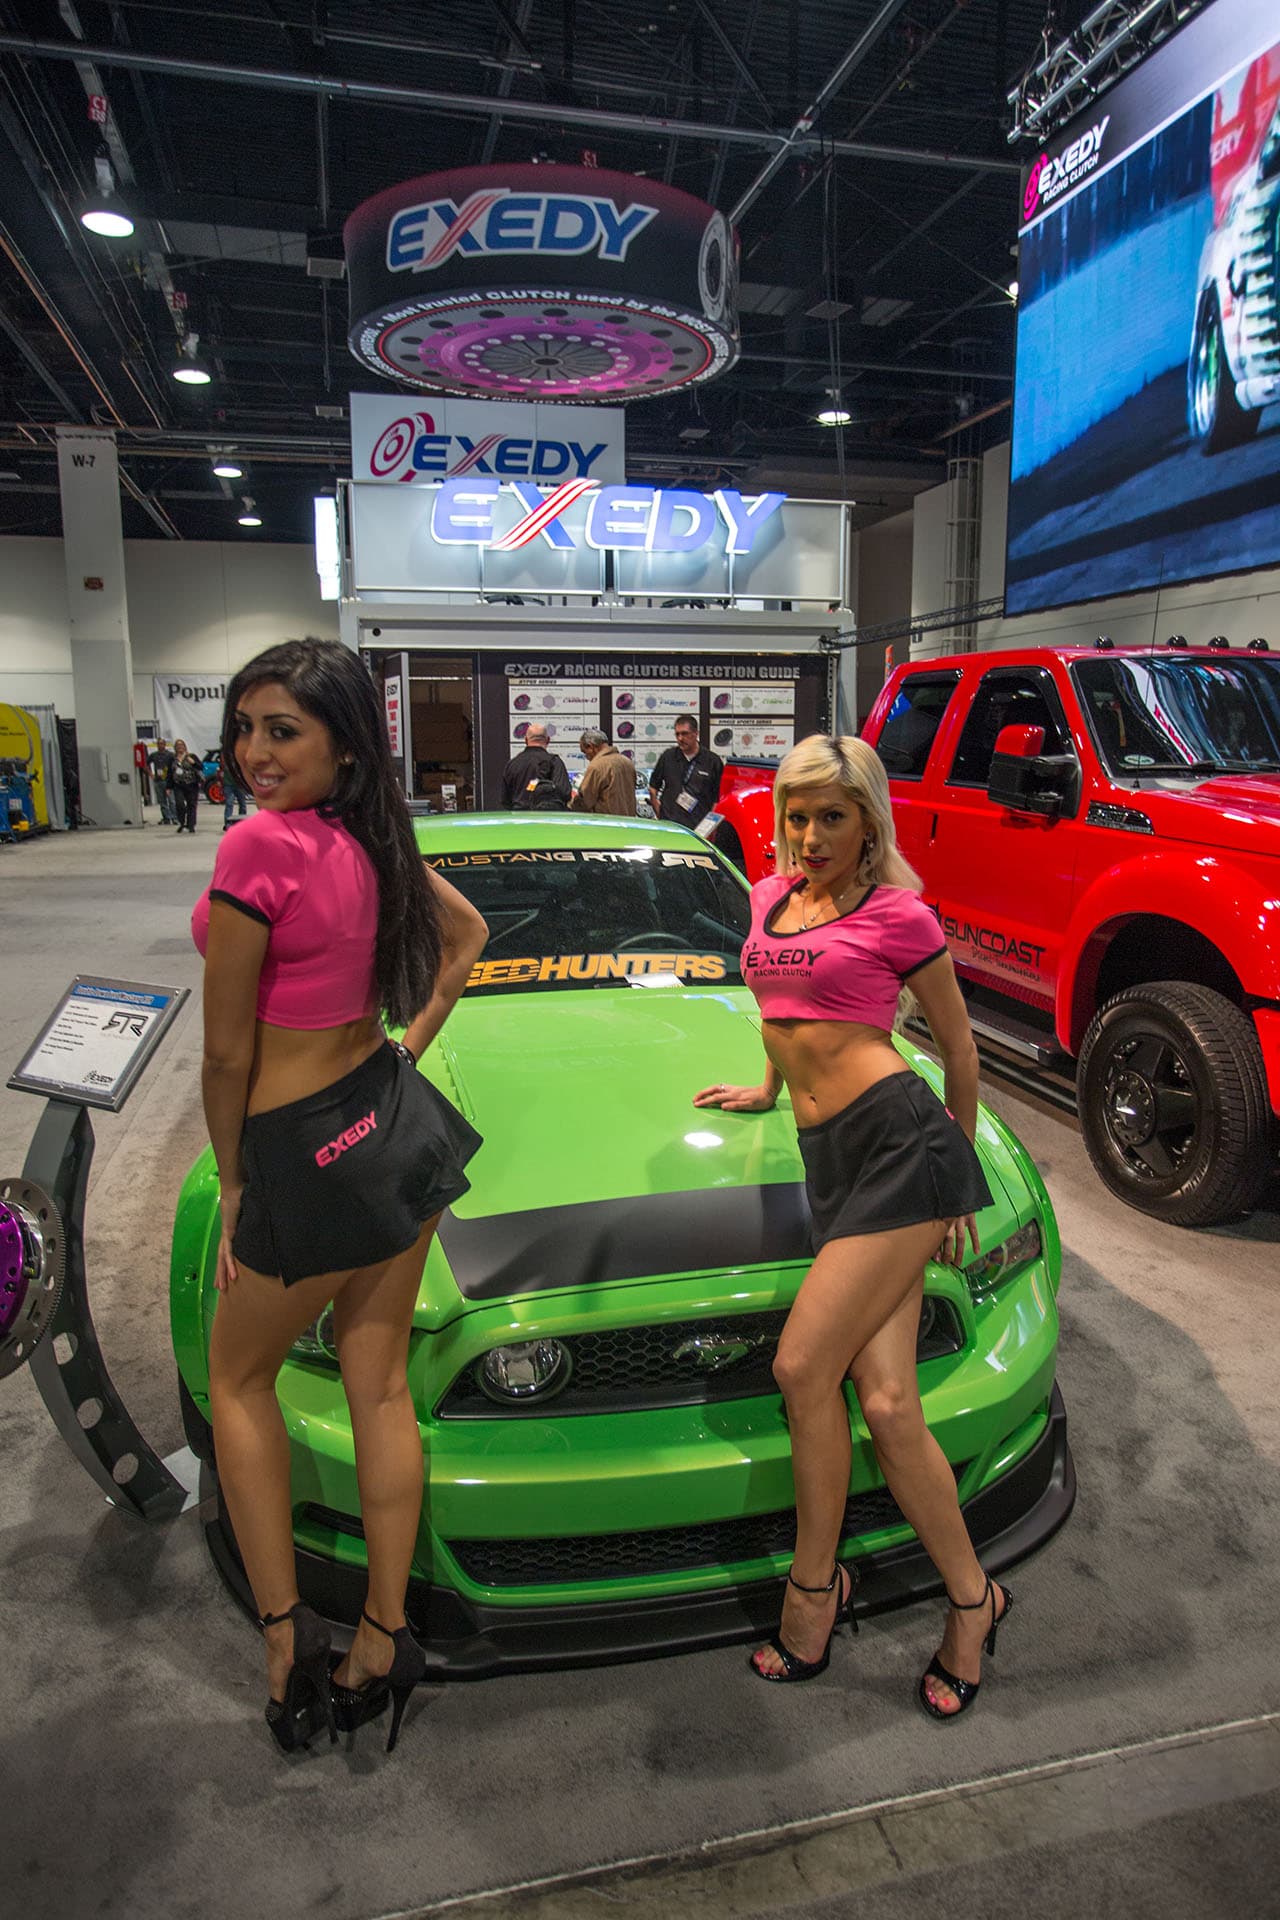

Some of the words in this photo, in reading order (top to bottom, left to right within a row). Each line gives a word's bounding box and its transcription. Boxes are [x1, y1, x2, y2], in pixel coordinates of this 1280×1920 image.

[1038, 115, 1110, 194] EXEDY
[1043, 176, 1069, 204] RACING
[1069, 152, 1100, 184] CLUTCH
[387, 188, 659, 273] EXEDY
[419, 293, 481, 311] trusted
[485, 290, 571, 300] CLUTCH
[575, 294, 625, 305] used
[625, 300, 650, 311] by
[650, 305, 678, 318] the
[71, 454, 96, 468] W-7
[412, 433, 608, 478] EXEDY
[430, 477, 788, 554] EXEDY
[504, 663, 562, 676] EXEDY
[564, 664, 620, 676] RACING
[623, 664, 679, 678] CLUTCH
[682, 665, 756, 679] SELECTION
[758, 666, 801, 679] GUIDE
[167, 683, 227, 702] Popul
[424, 851, 577, 869] MUSTANG
[746, 949, 826, 968] EXEDY
[944, 917, 1046, 968] SUNCOAST
[466, 954, 727, 986] EEDHUNTERS
[753, 968, 780, 977] RACING
[782, 968, 812, 978] CLUTCH
[314, 1110, 378, 1169] EXEDY
